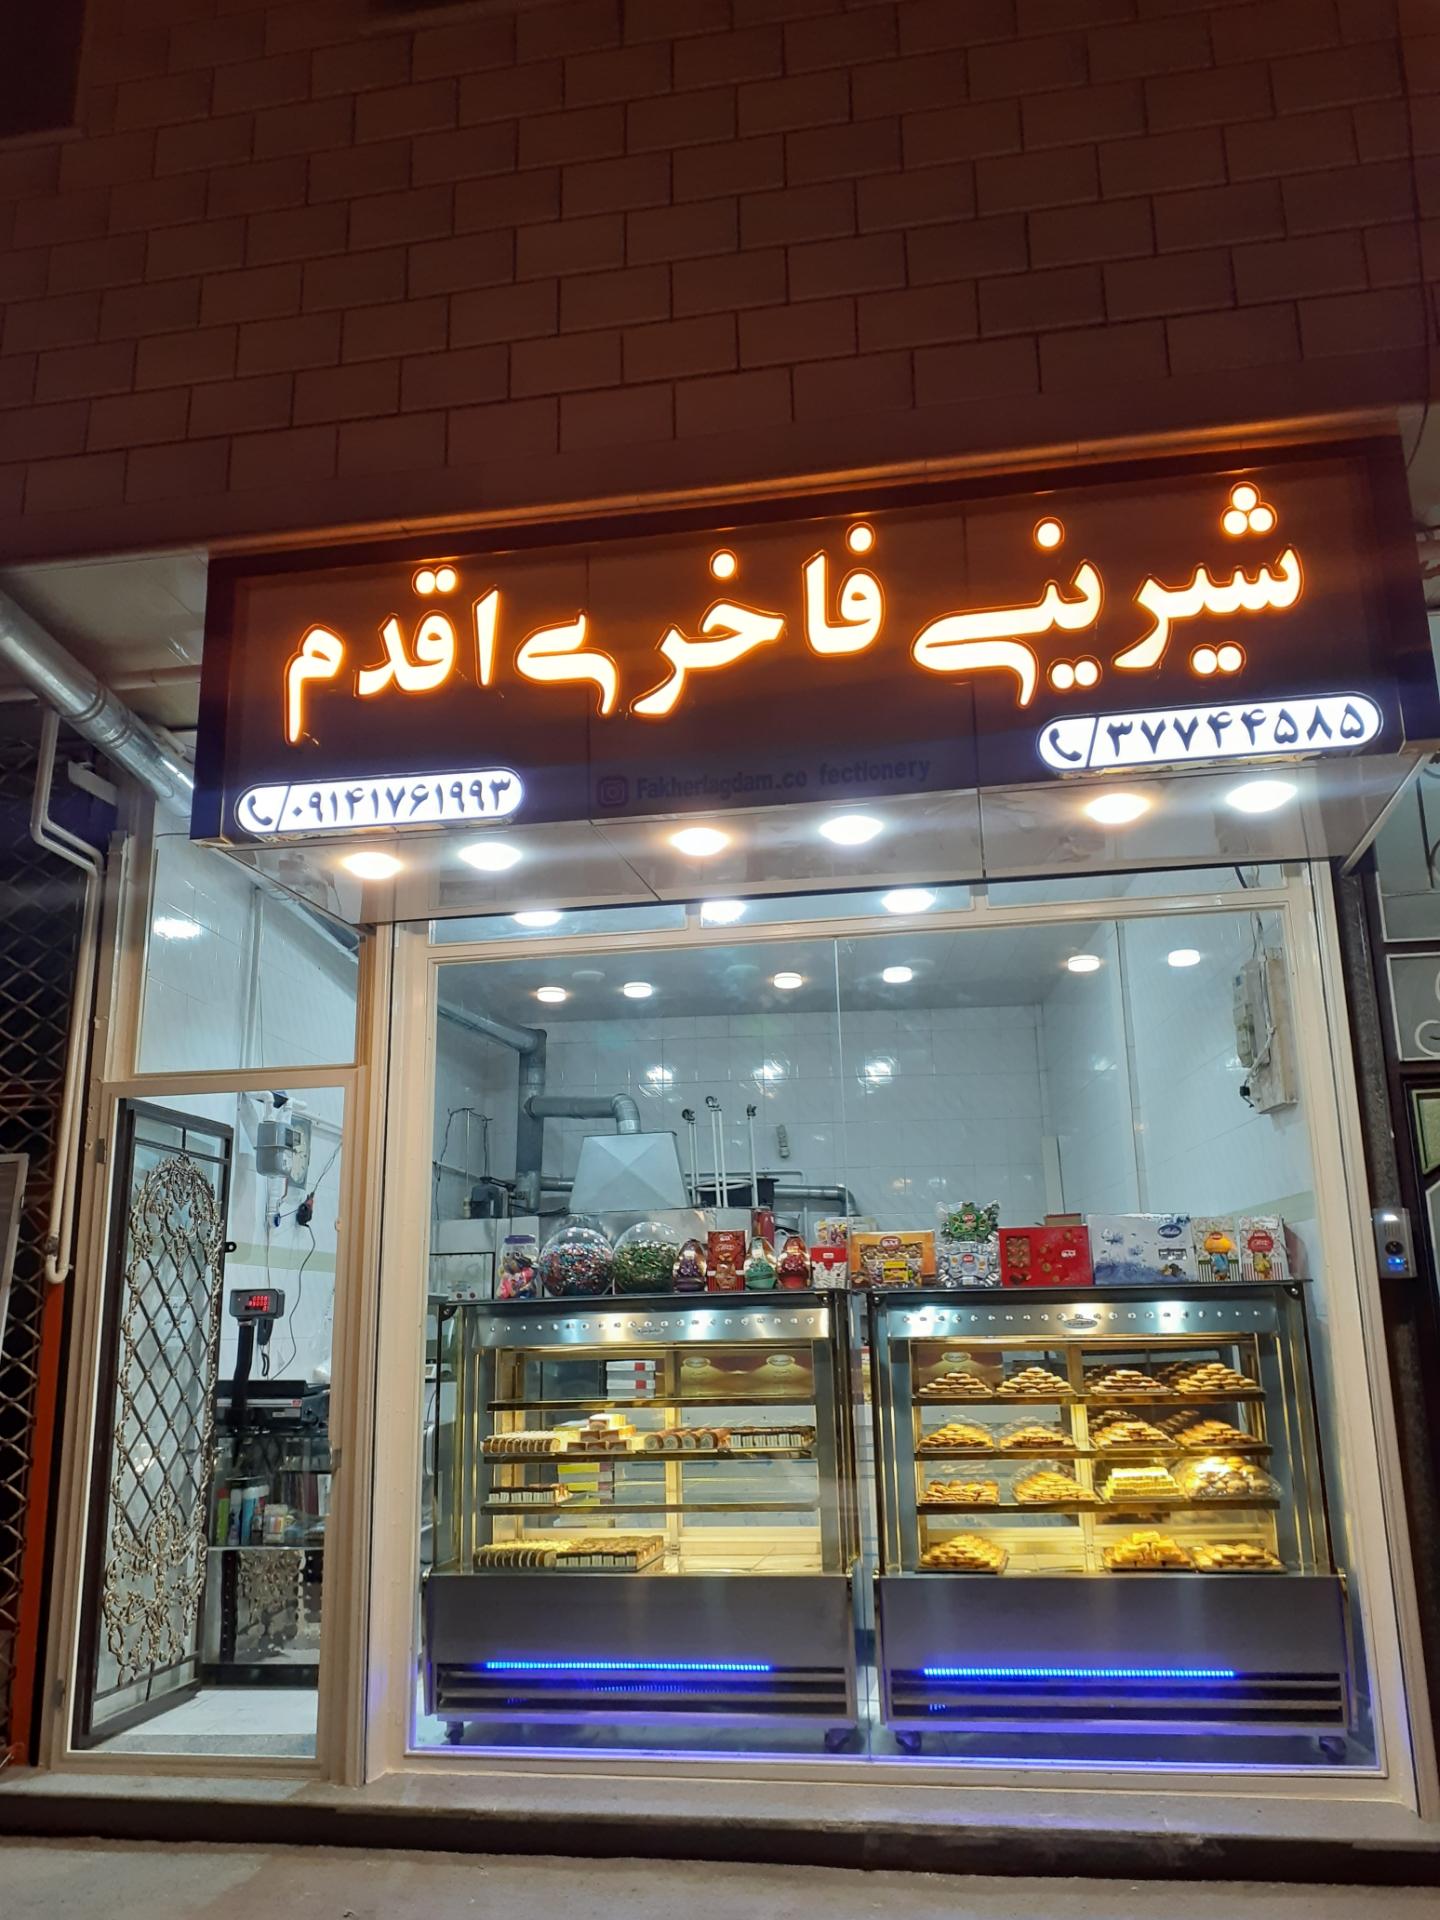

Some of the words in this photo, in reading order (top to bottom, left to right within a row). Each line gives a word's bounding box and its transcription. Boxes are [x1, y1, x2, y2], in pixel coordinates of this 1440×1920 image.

[284, 565, 500, 745] اقدم
[512, 521, 886, 717] فاخری
[911, 482, 1304, 708] شیرینی
[292, 777, 512, 823] ۰۹۱۴۱۷۶۱۹۹۳
[1106, 702, 1366, 757] ۳۷۷۴۴۵۸۵
